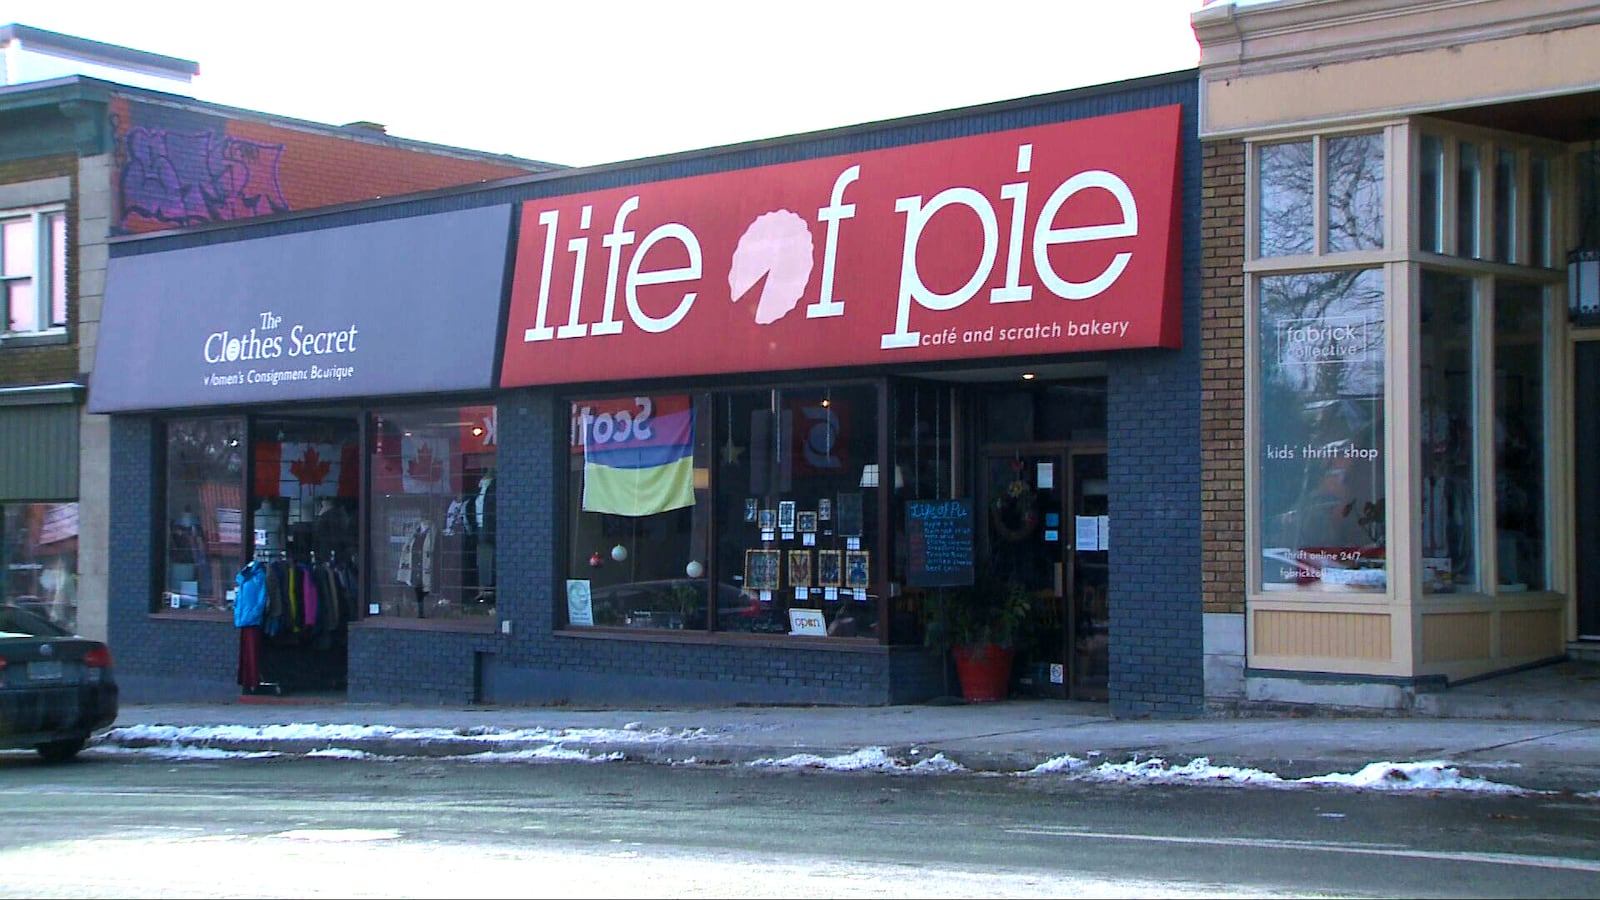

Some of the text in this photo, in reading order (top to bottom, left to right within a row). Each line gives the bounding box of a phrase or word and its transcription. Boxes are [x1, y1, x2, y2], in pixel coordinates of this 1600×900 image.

[524, 195, 703, 342] life
[880, 143, 1139, 349] pie
[259, 311, 282, 330] The
[921, 319, 1130, 346] café and scratch bakery
[1287, 324, 1356, 342] fabrick
[204, 324, 358, 363] Clothes Secret
[1302, 444, 1338, 459] thrift
[1343, 443, 1378, 461] shop
[1309, 550, 1338, 560] online
[1340, 551, 1361, 561] 24/7
[794, 618, 821, 629] open
